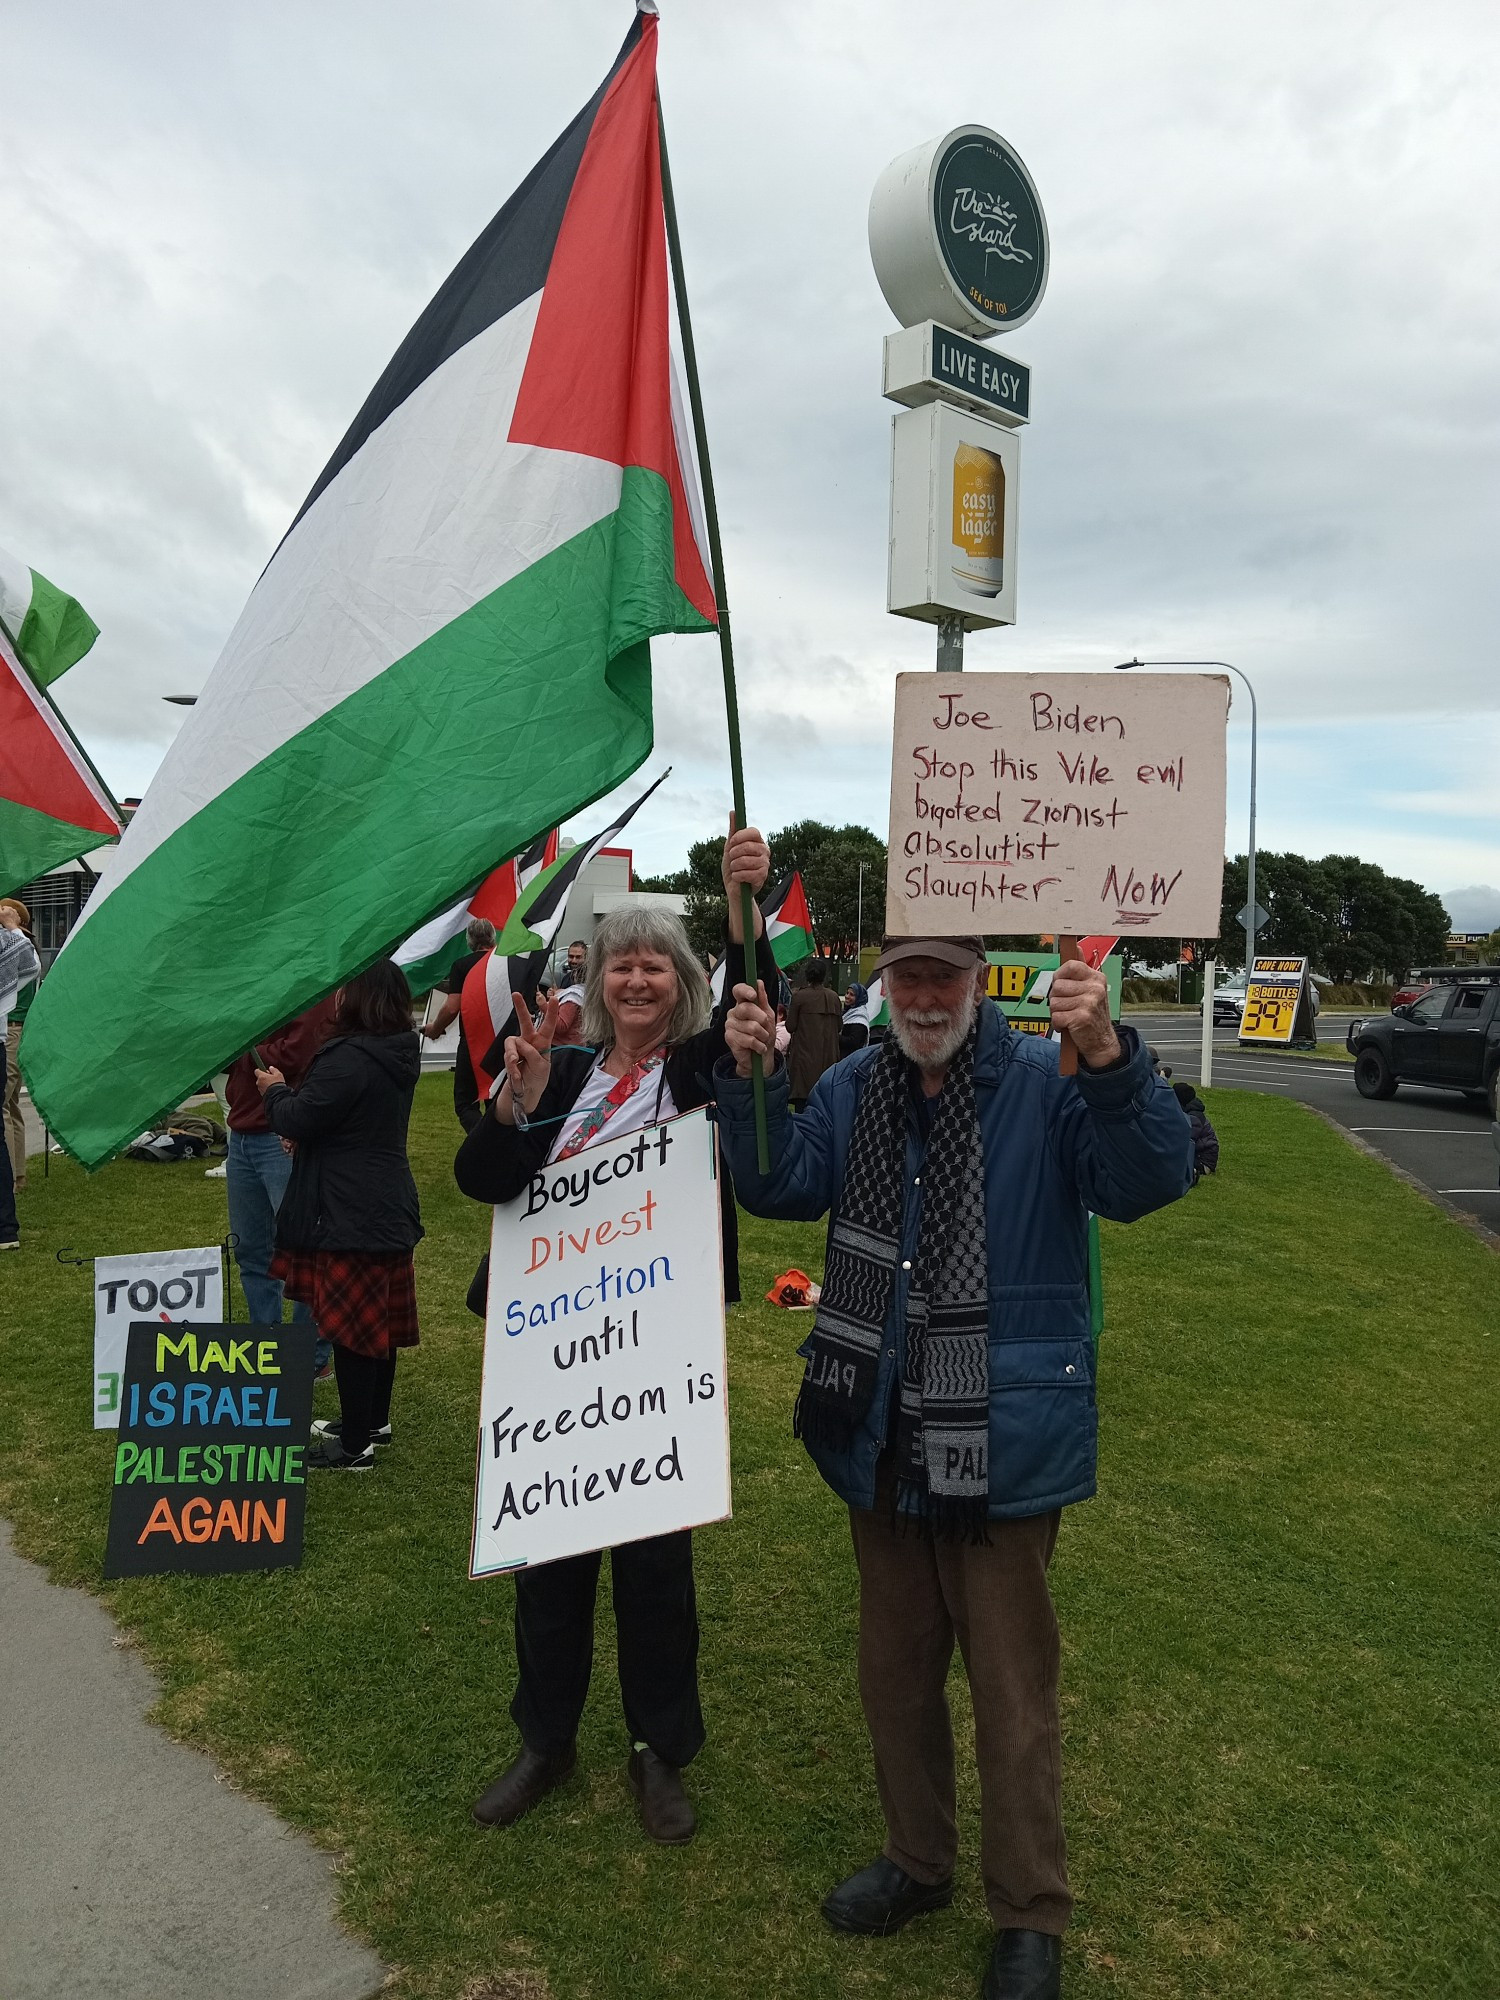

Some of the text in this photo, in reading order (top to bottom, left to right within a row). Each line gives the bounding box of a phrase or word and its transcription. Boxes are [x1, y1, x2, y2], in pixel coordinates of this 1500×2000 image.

[950, 197, 1030, 258] Island
[969, 286, 982, 304] SEA
[984, 298, 993, 311] OF
[941, 343, 1020, 403] LIVE EASY
[960, 513, 997, 544] lager
[962, 491, 996, 518] easy
[932, 691, 1126, 739] Joe Biden
[912, 745, 1184, 792] Stop this Vile evil
[915, 782, 1001, 830] bigoted
[904, 863, 1062, 912] Slaughter
[1255, 961, 1301, 972] SAVE NOW!
[1244, 999, 1295, 1031] 39 99
[1260, 986, 1299, 999] BOTTLES
[519, 1125, 674, 1222] Boycott
[524, 1190, 657, 1275] Divest
[98, 1266, 220, 1315] TOOT
[505, 1256, 674, 1337] Sanction
[156, 1331, 282, 1375] MAKE
[553, 1309, 639, 1370] until
[129, 1381, 292, 1428] ISRAEL
[492, 1362, 715, 1459] Freedom is
[114, 1441, 306, 1486] PALESTINE
[491, 1436, 684, 1531] Achieved
[137, 1496, 287, 1545] AGAIN
